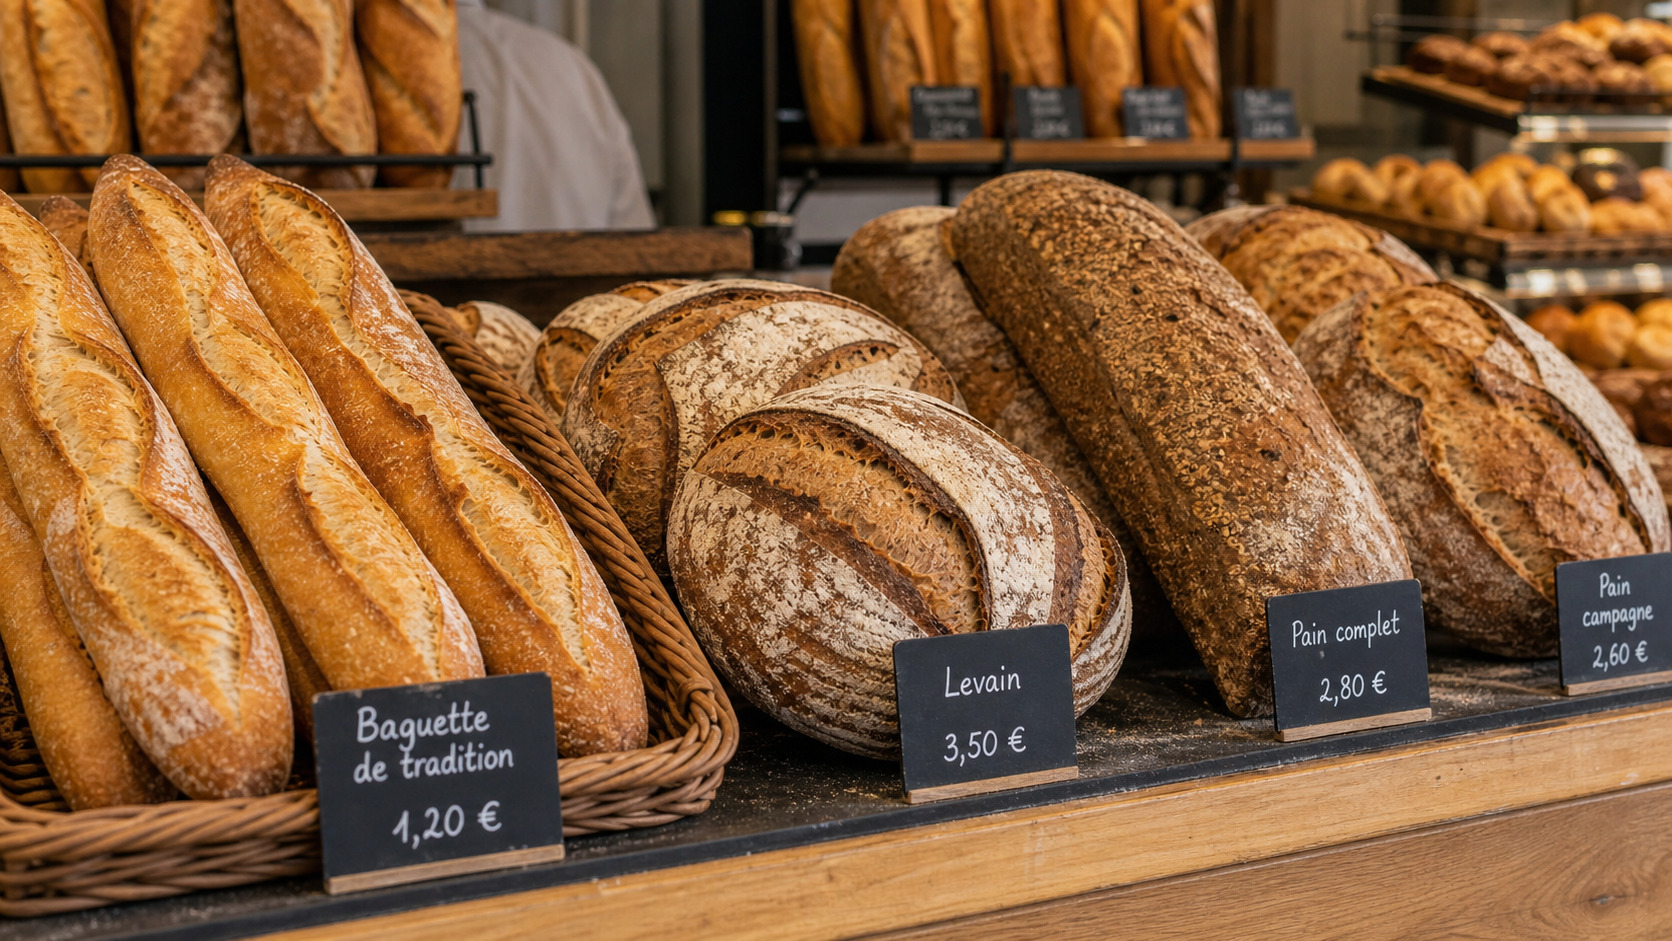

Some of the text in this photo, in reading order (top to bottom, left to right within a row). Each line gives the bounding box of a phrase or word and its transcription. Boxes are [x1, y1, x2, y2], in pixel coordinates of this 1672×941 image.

[1600, 572, 1631, 598] Pain
[1291, 609, 1400, 648] Pain complet
[1582, 604, 1654, 633] campagne
[1592, 640, 1648, 672] 2,60 €
[944, 665, 1021, 698] Levain
[1319, 670, 1388, 707] 2,80 €
[356, 700, 490, 751] Baguette
[353, 742, 514, 784] de tradition
[943, 726, 1027, 767] 3,50 €
[392, 800, 502, 850] 1,20 €
